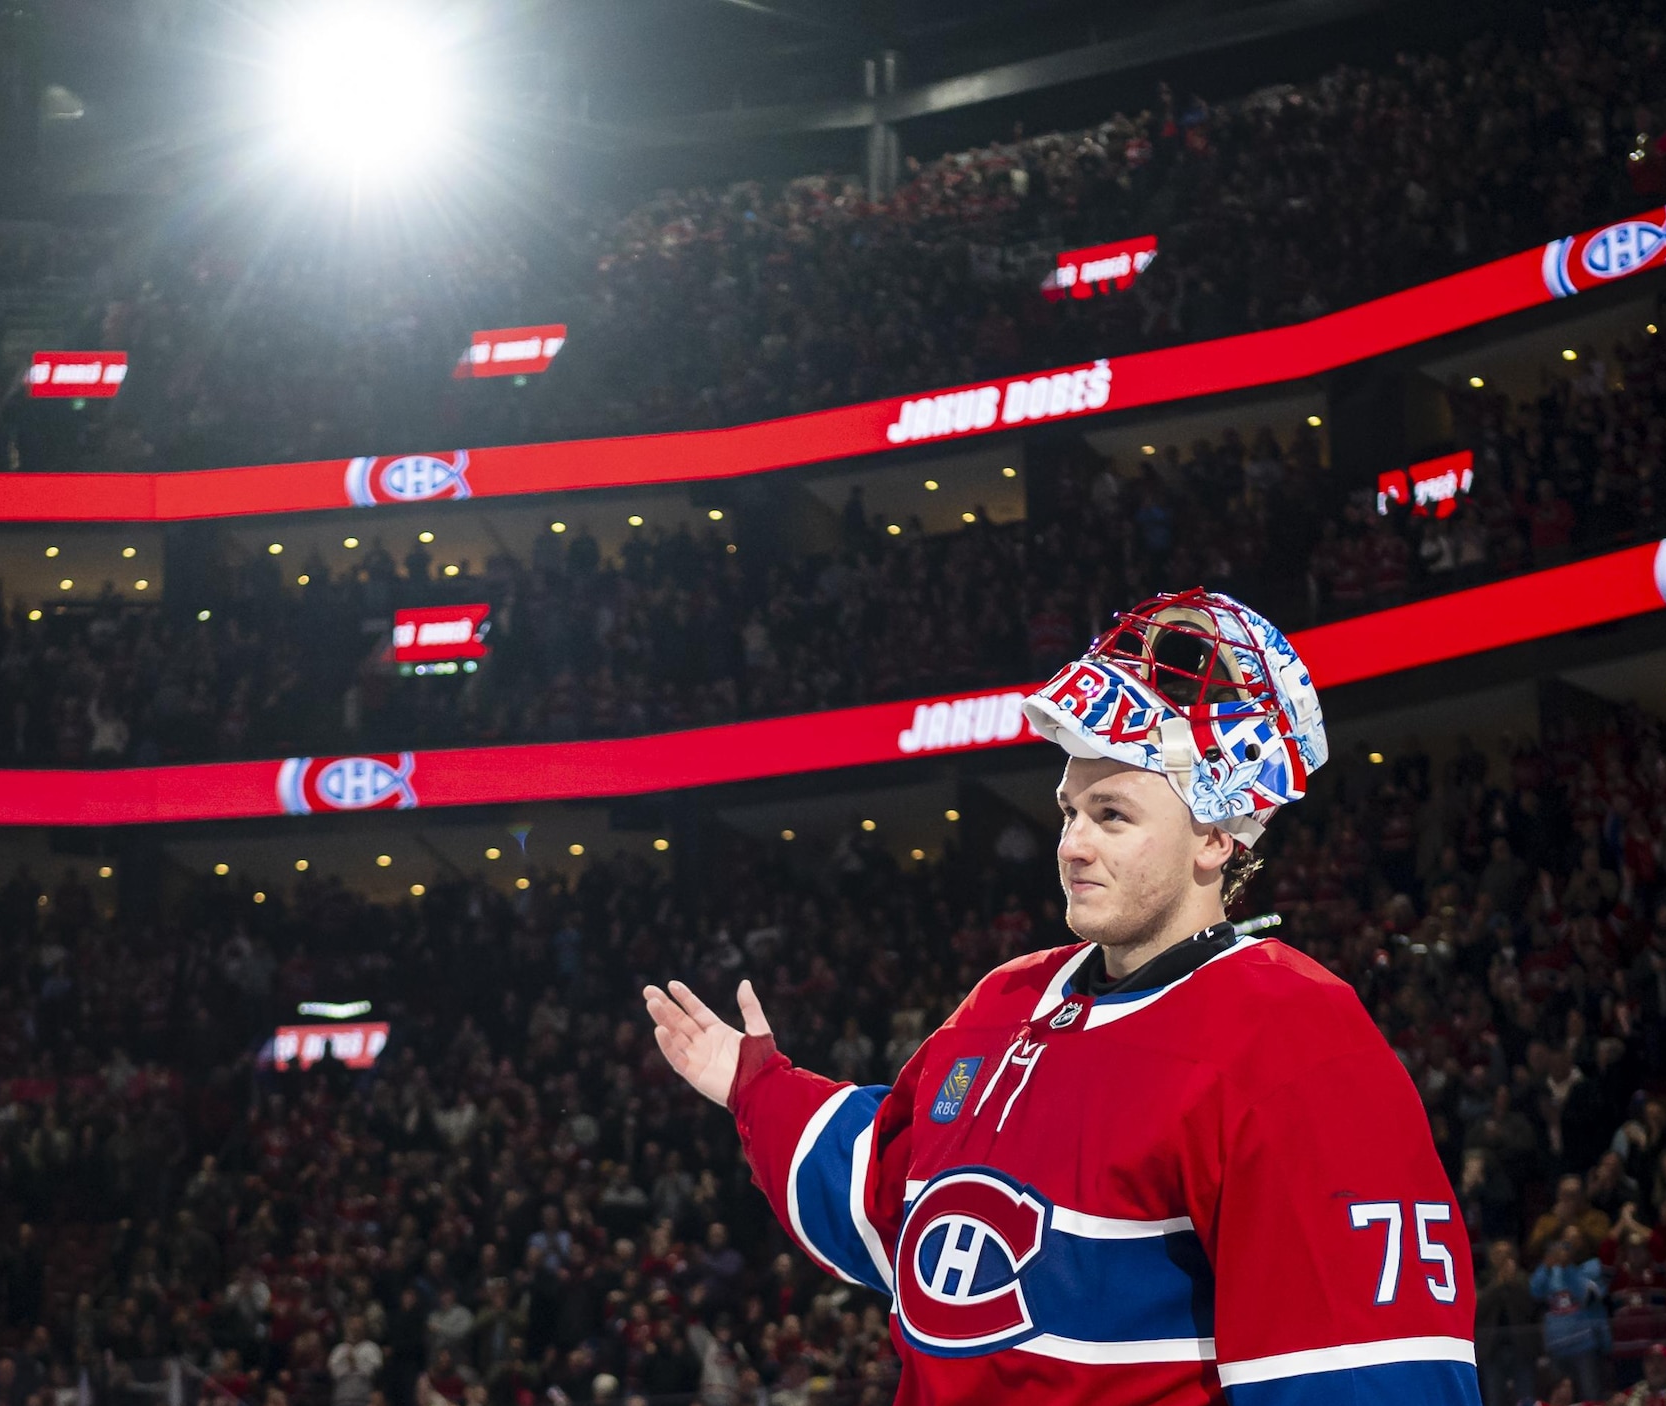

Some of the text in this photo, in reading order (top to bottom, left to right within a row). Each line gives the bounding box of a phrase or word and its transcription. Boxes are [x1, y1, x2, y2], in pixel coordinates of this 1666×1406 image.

[887, 359, 1112, 443] JAKUB DOBEŠ
[898, 692, 1025, 753] JAKUB
[934, 1100, 959, 1116] RBC
[1349, 1201, 1457, 1305] 75
